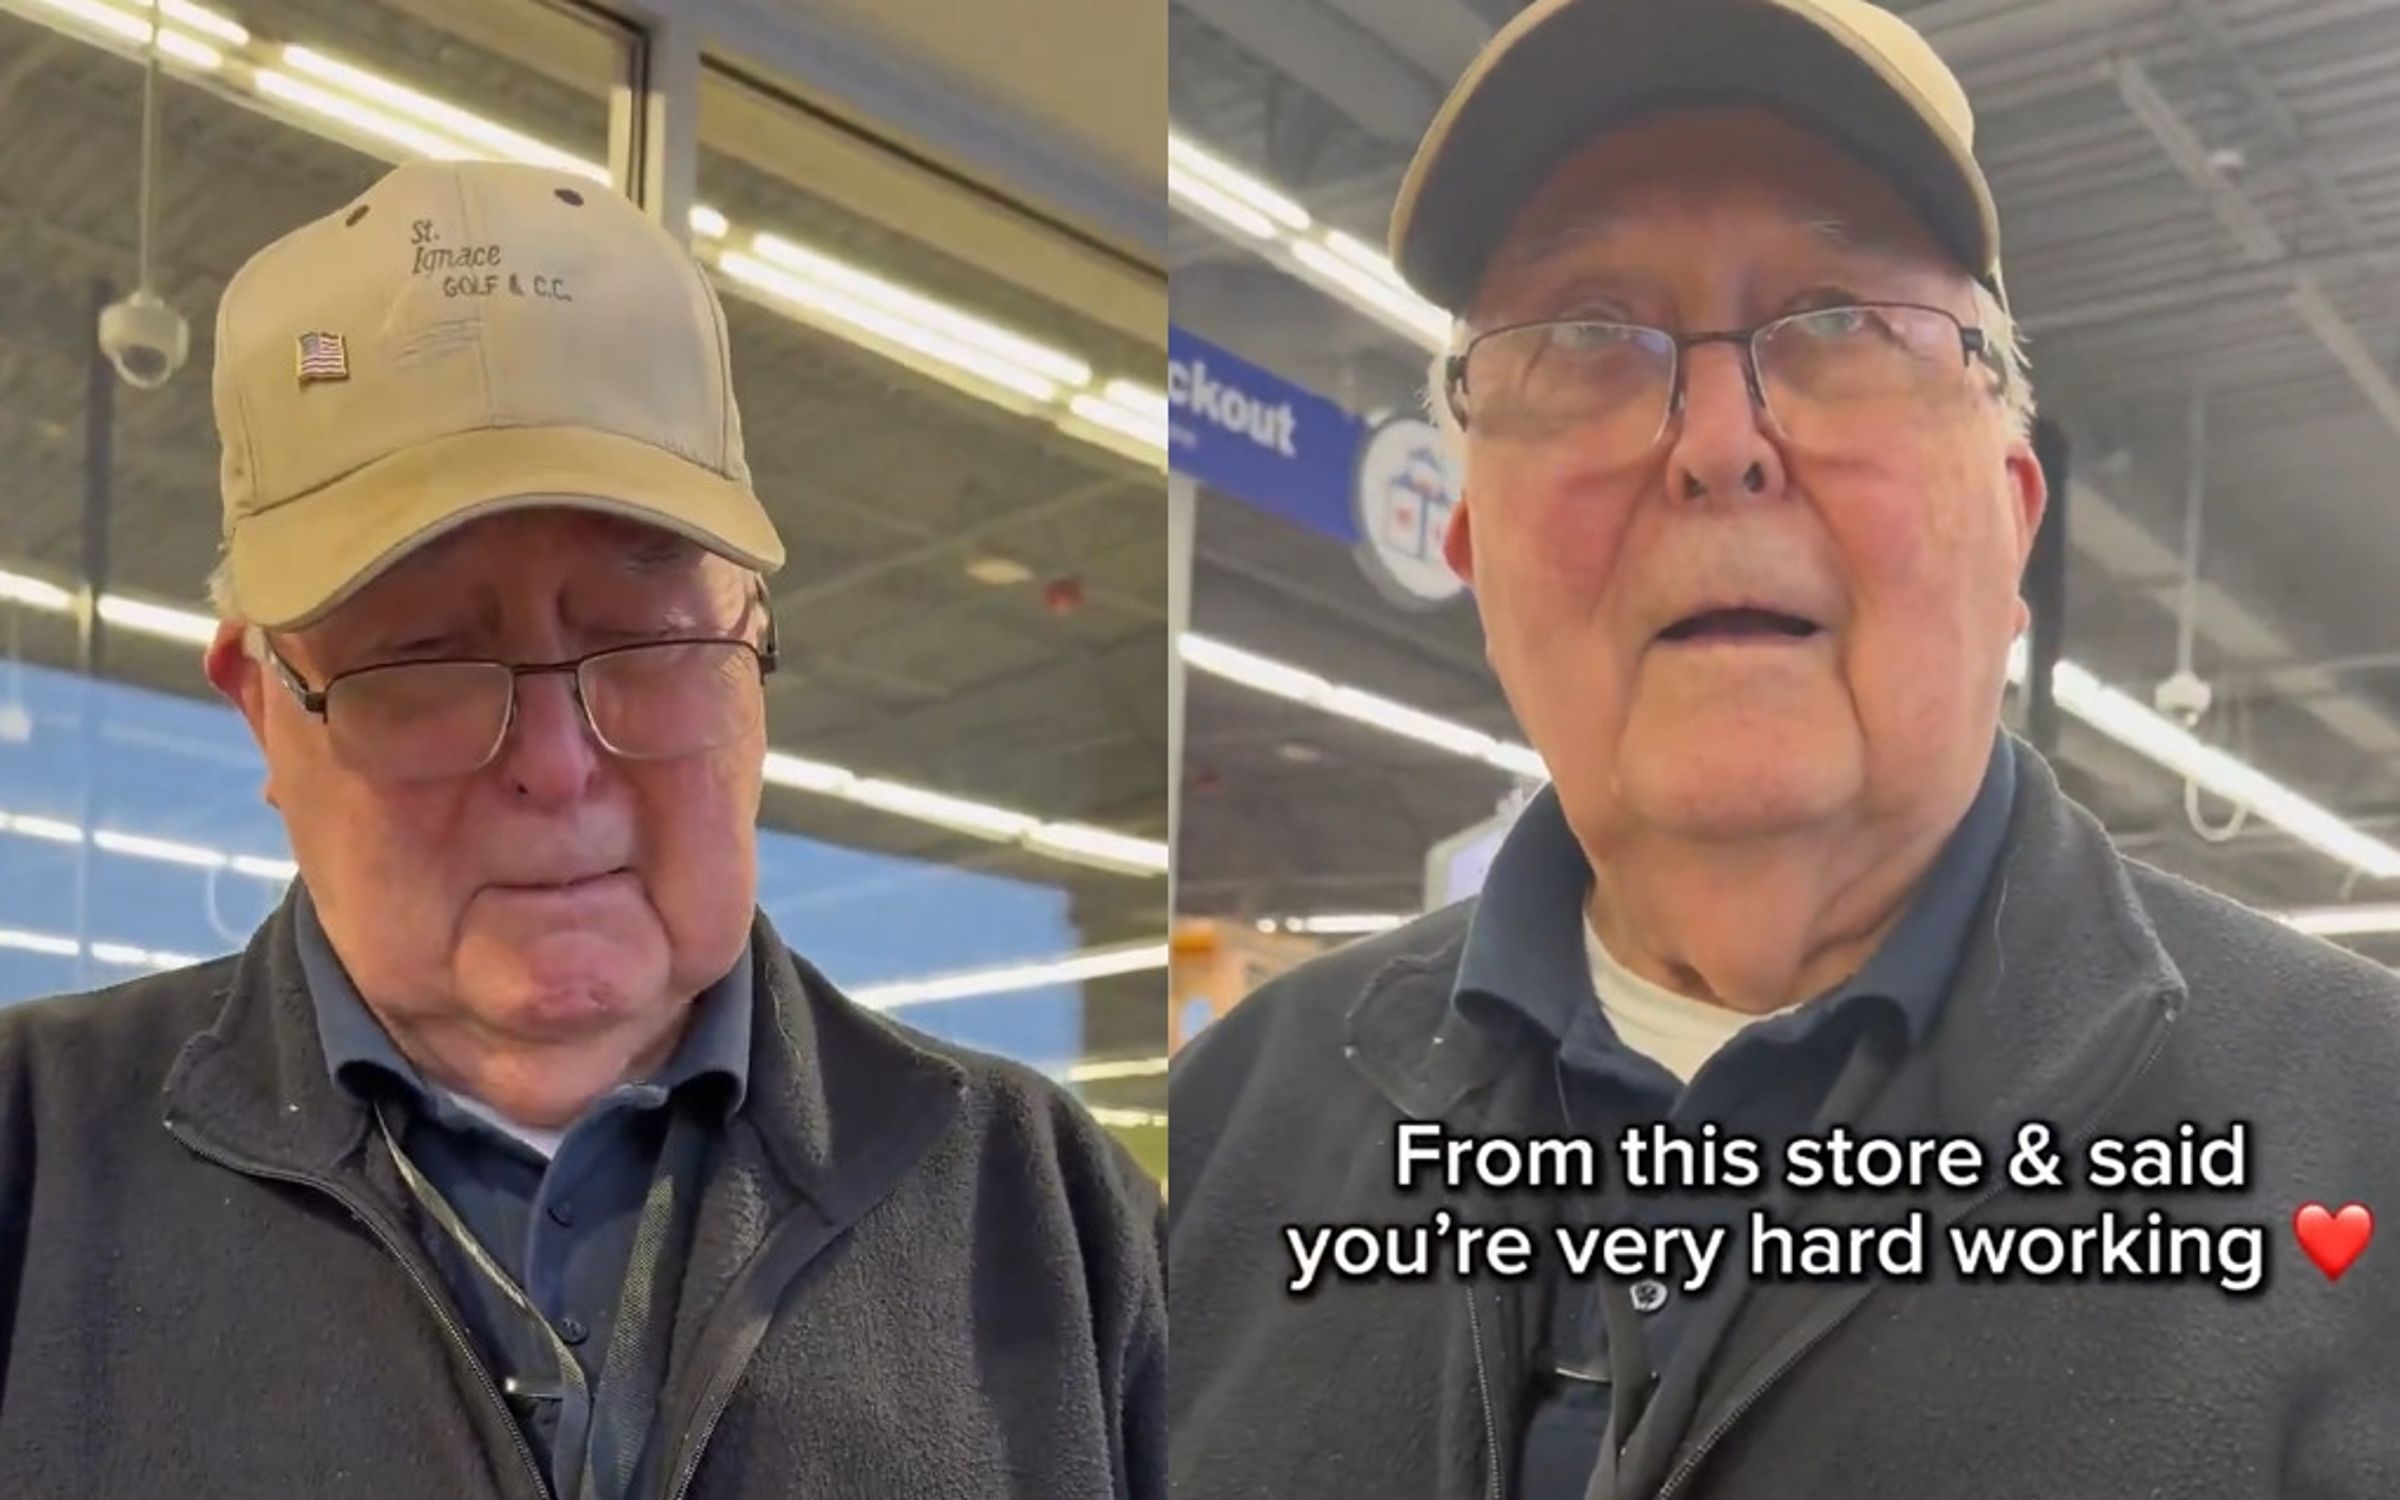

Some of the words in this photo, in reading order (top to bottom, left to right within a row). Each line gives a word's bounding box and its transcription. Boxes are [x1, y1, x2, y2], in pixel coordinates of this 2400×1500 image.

[411, 220, 440, 244] St.
[412, 245, 502, 277] Ignace
[443, 275, 499, 298] GOLF
